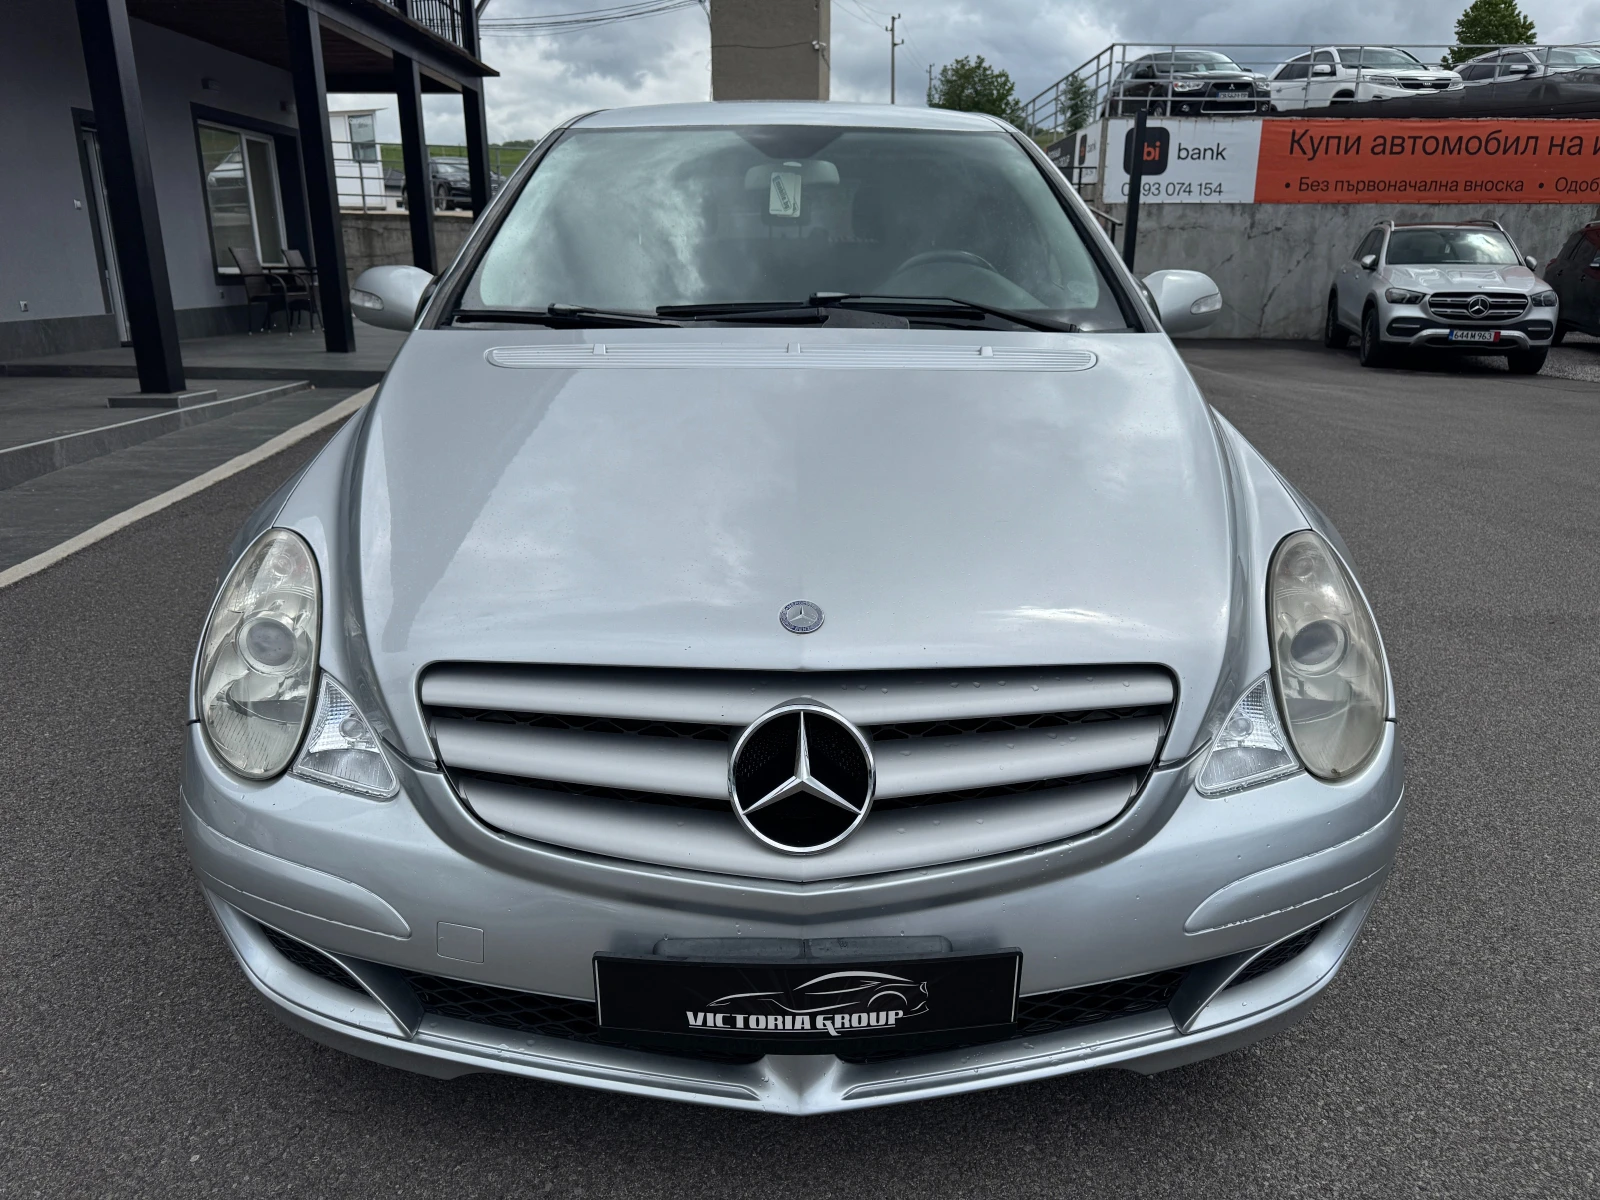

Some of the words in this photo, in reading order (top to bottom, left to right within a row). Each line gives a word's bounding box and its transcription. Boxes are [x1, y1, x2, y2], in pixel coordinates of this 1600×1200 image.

[1143, 140, 1161, 161] bi
[1177, 142, 1227, 161] bank
[1289, 128, 1362, 161] Купи
[1370, 129, 1540, 156] автомобил
[1547, 135, 1584, 156] на
[1121, 182, 1161, 197] 093
[1165, 182, 1193, 197] 074
[1197, 182, 1224, 197] 154
[1298, 176, 1330, 192] Без
[1334, 180, 1459, 195] първоначална
[1463, 180, 1524, 192] вноска
[1555, 176, 1600, 195] Одоб
[685, 1011, 811, 1030] VICTORIA
[815, 1010, 904, 1036] GROUP
